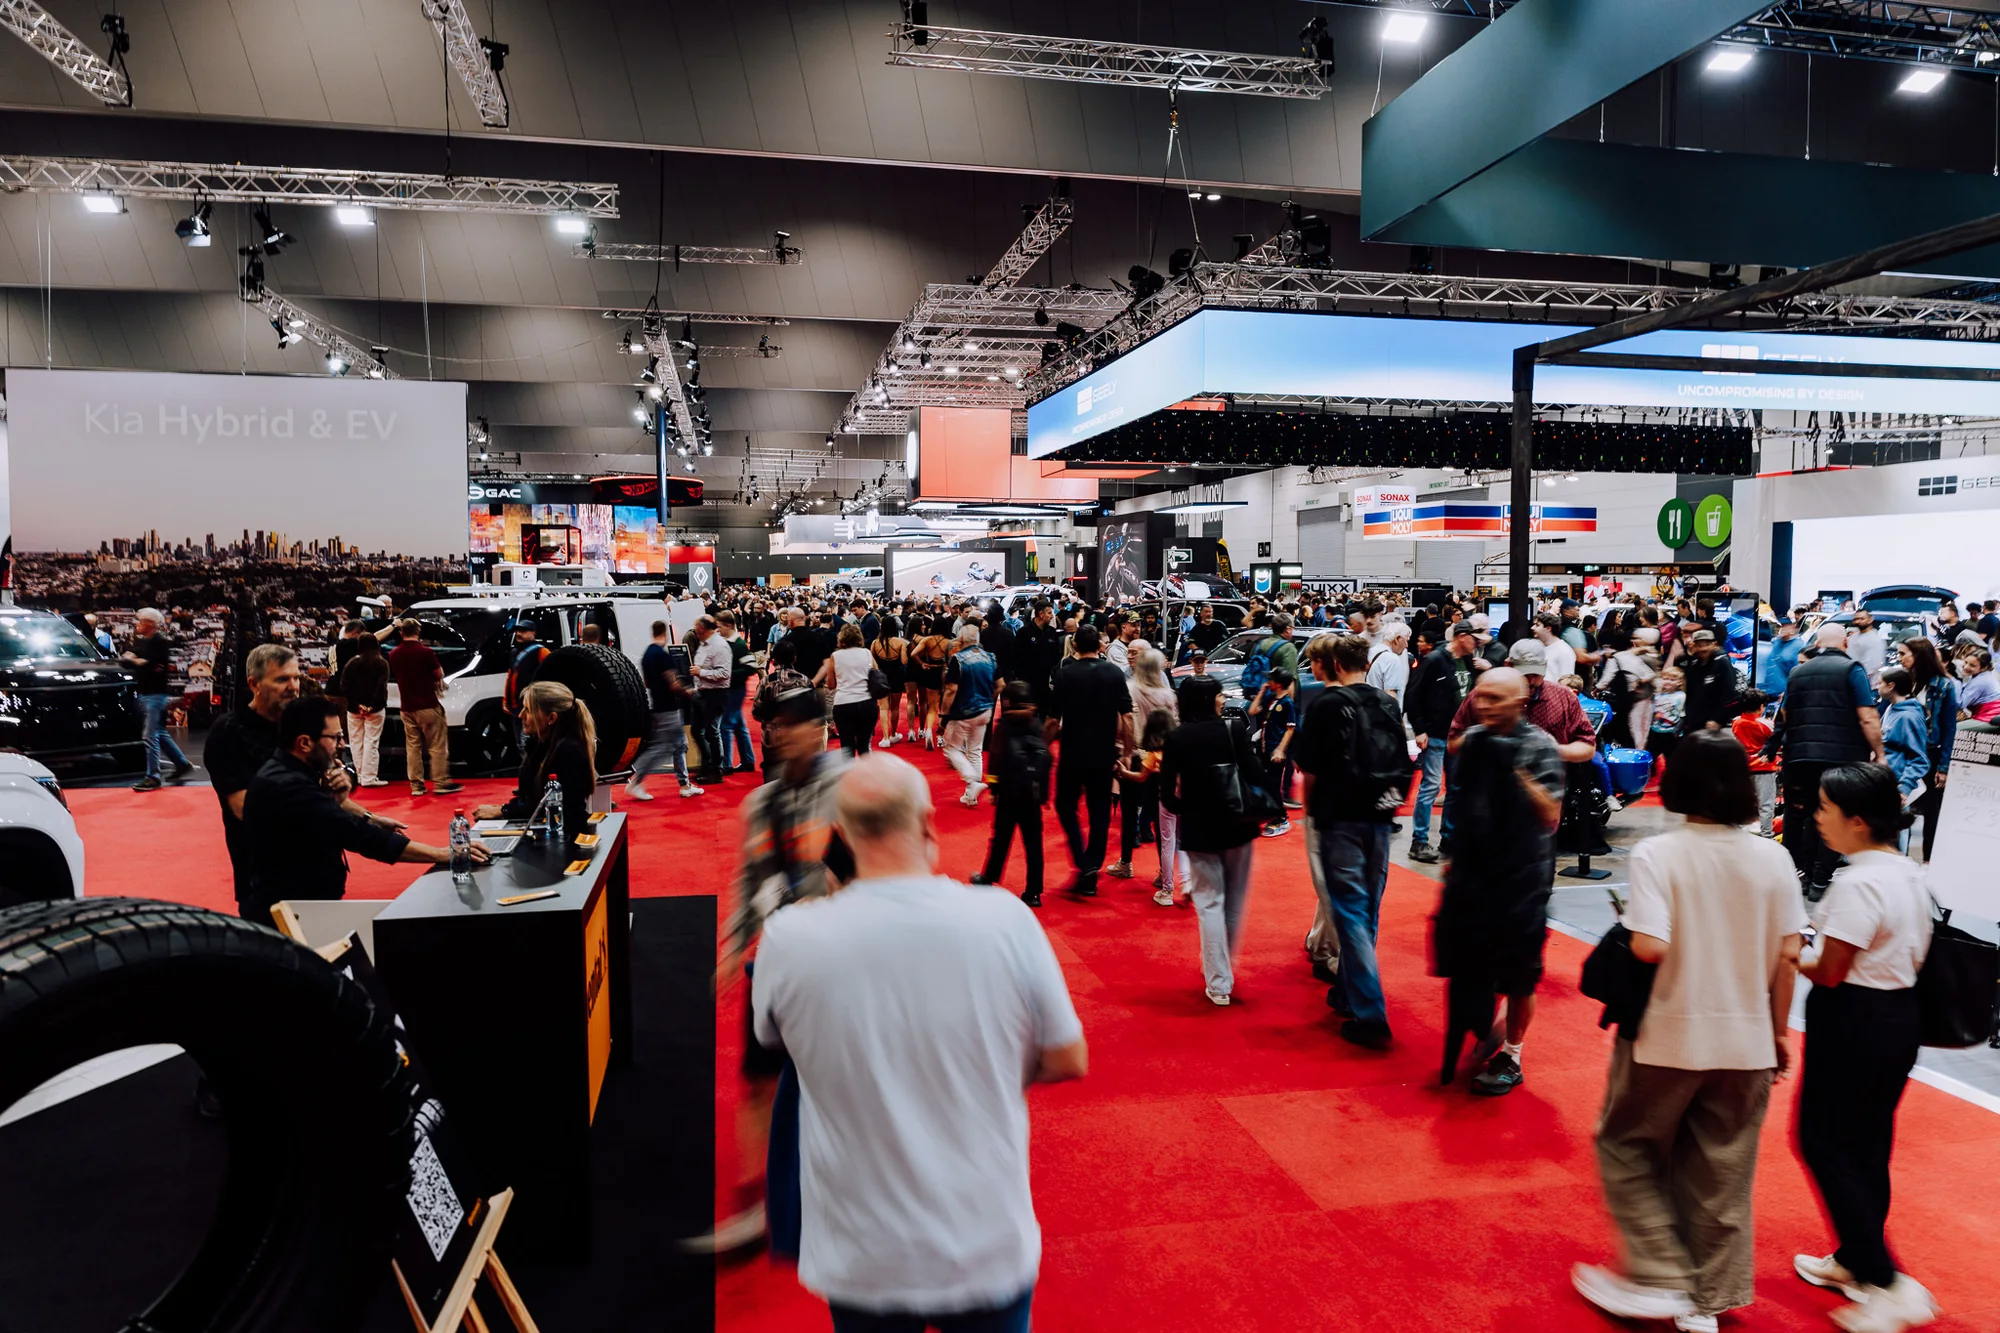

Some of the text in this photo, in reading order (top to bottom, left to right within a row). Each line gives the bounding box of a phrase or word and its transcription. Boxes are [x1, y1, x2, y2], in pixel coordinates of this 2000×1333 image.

[1677, 384, 1865, 401] UNCOMPROMISING BY DESIGN
[84, 401, 398, 444] Kia Hybrid & EV
[485, 488, 522, 499] GAC
[1356, 495, 1372, 503] SONAX
[1380, 493, 1410, 502] SONAX
[1392, 508, 1412, 521] LIQUI
[1503, 505, 1540, 519] LUI
[1392, 521, 1412, 535] MOLY
[1503, 519, 1540, 532] MY
